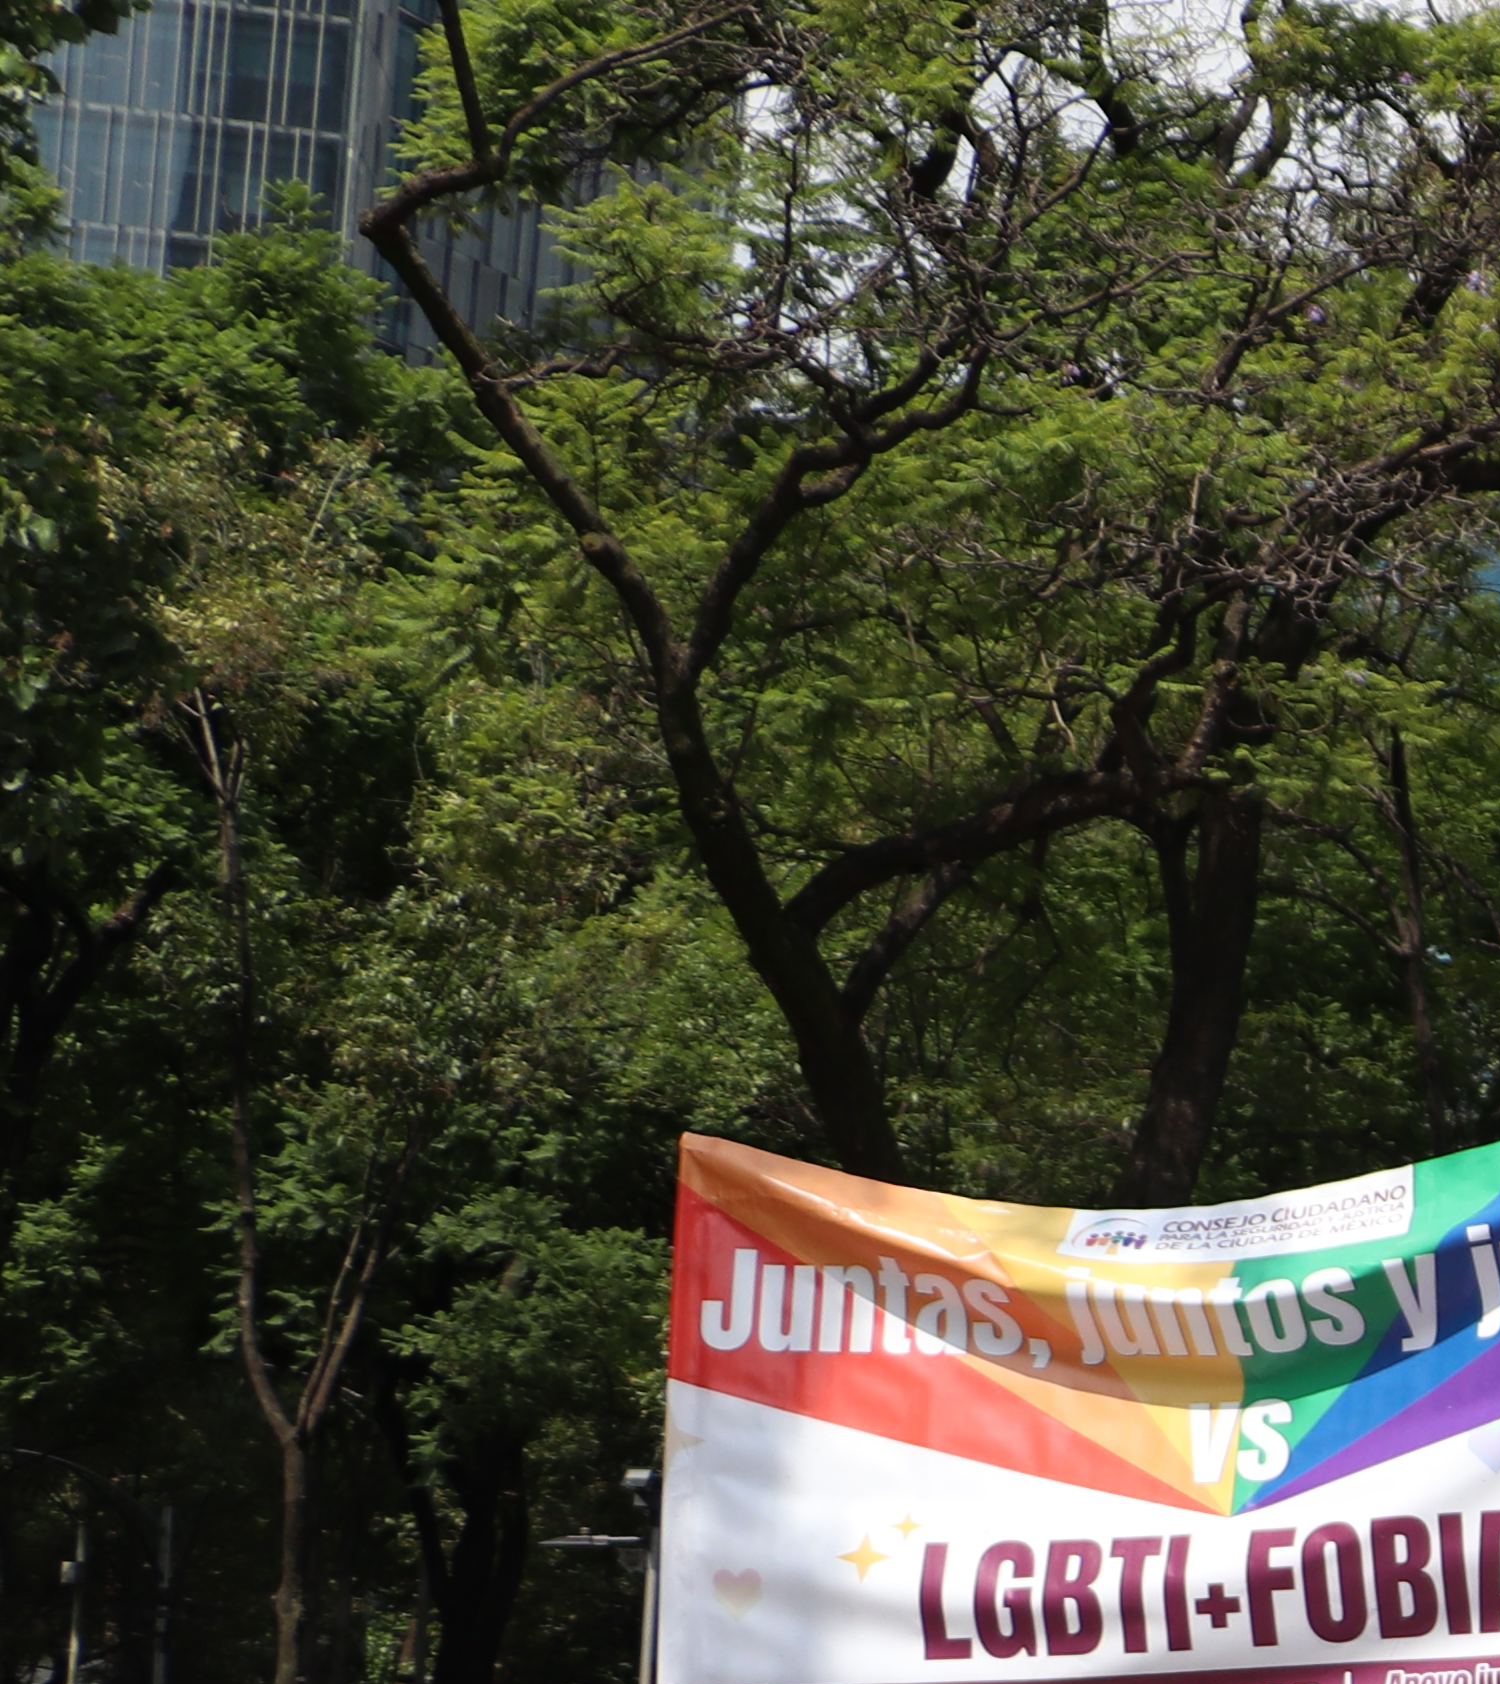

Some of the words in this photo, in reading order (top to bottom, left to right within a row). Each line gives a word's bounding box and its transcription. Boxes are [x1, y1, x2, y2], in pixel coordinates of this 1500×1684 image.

[1158, 1230, 1204, 1241] PARA
[1205, 1228, 1229, 1240] LA
[1230, 1216, 1323, 1238] SEGURIDAD
[1324, 1213, 1336, 1224] Y
[1339, 1201, 1406, 1221] JUSTICIA
[1163, 1213, 1266, 1233] CONSEJO
[1271, 1185, 1406, 1223] CIUDADANO
[1155, 1240, 1185, 1251] DE
[1187, 1239, 1212, 1250] LA
[1216, 1231, 1293, 1249] CIUDAD
[1298, 1226, 1322, 1239] DE
[1329, 1212, 1404, 1235] MÉXICO
[701, 1249, 1053, 1369] Juntas,
[1067, 1265, 1366, 1365] juntos
[1382, 1252, 1438, 1352] y
